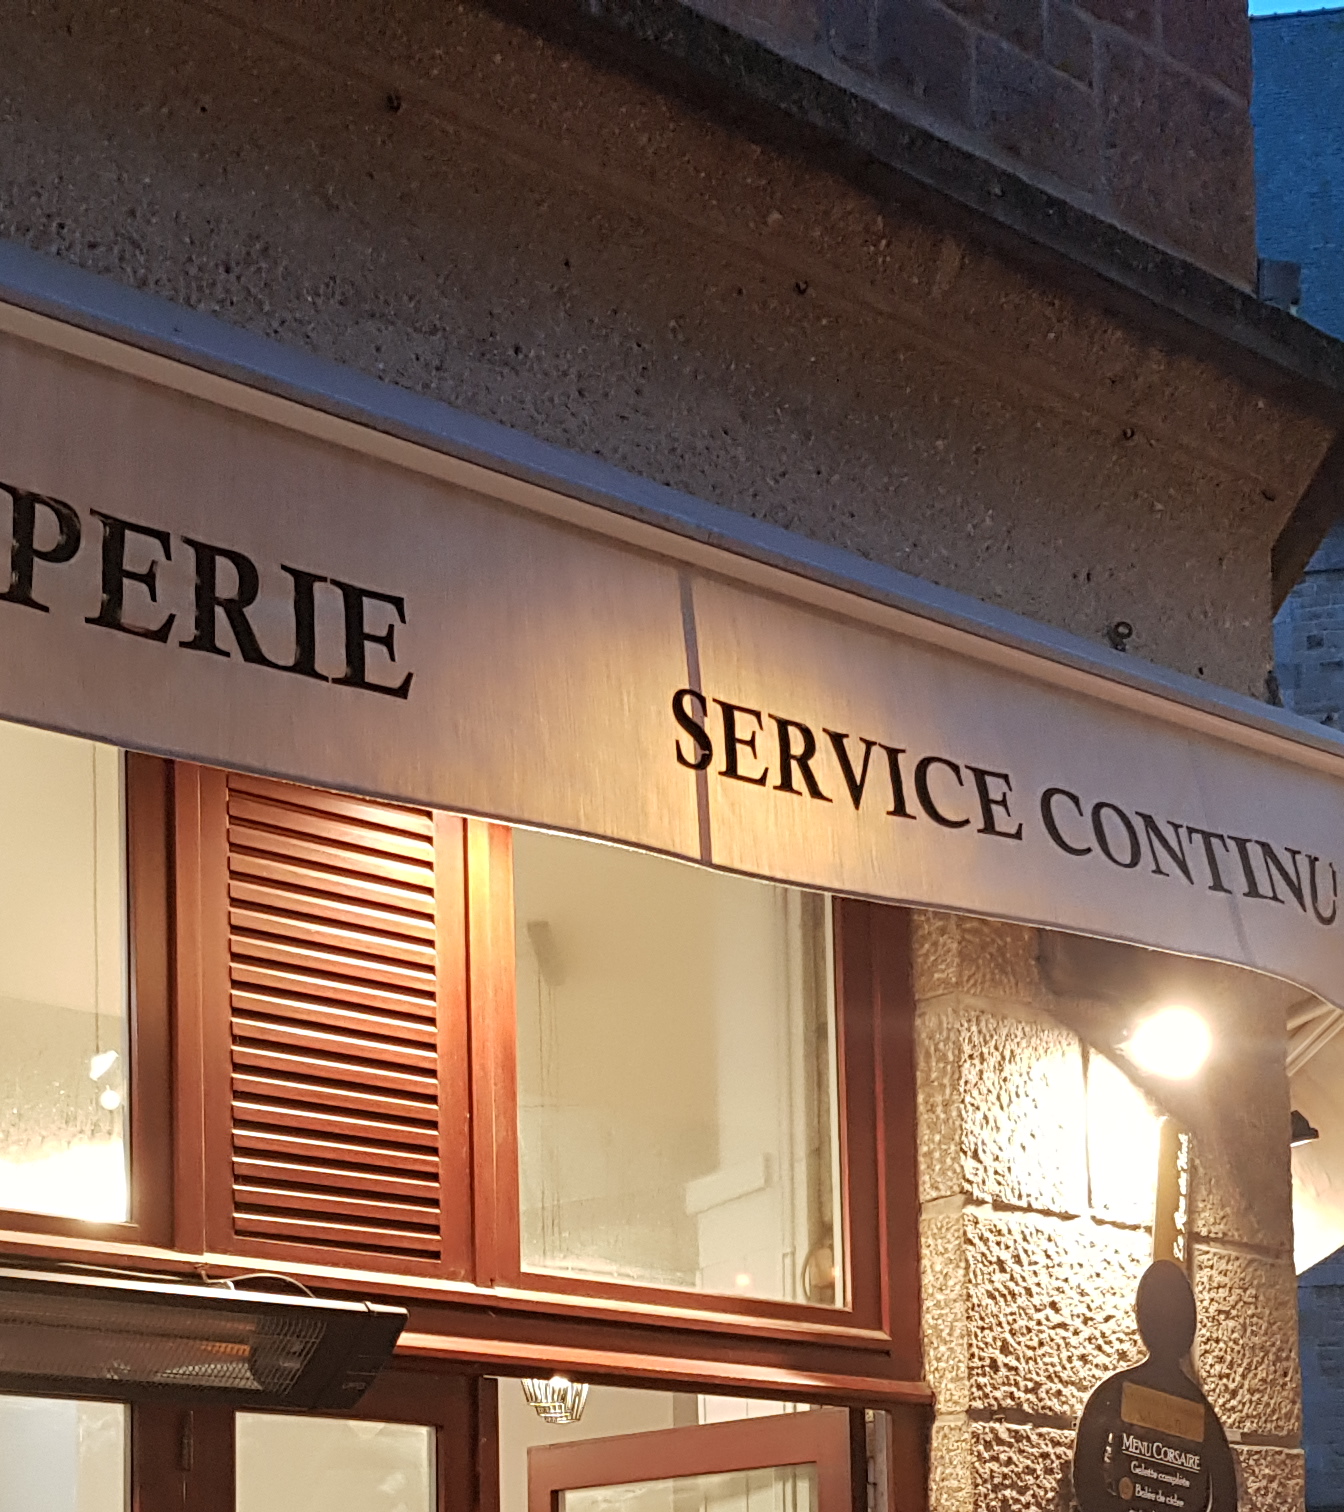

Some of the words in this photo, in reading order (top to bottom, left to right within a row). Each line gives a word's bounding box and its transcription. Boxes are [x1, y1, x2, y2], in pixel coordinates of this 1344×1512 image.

[672, 687, 1023, 841] SERVICE
[1039, 787, 1338, 926] CONTINU
[1122, 1433, 1152, 1457] MENU
[1153, 1442, 1201, 1470] CORSAIRE
